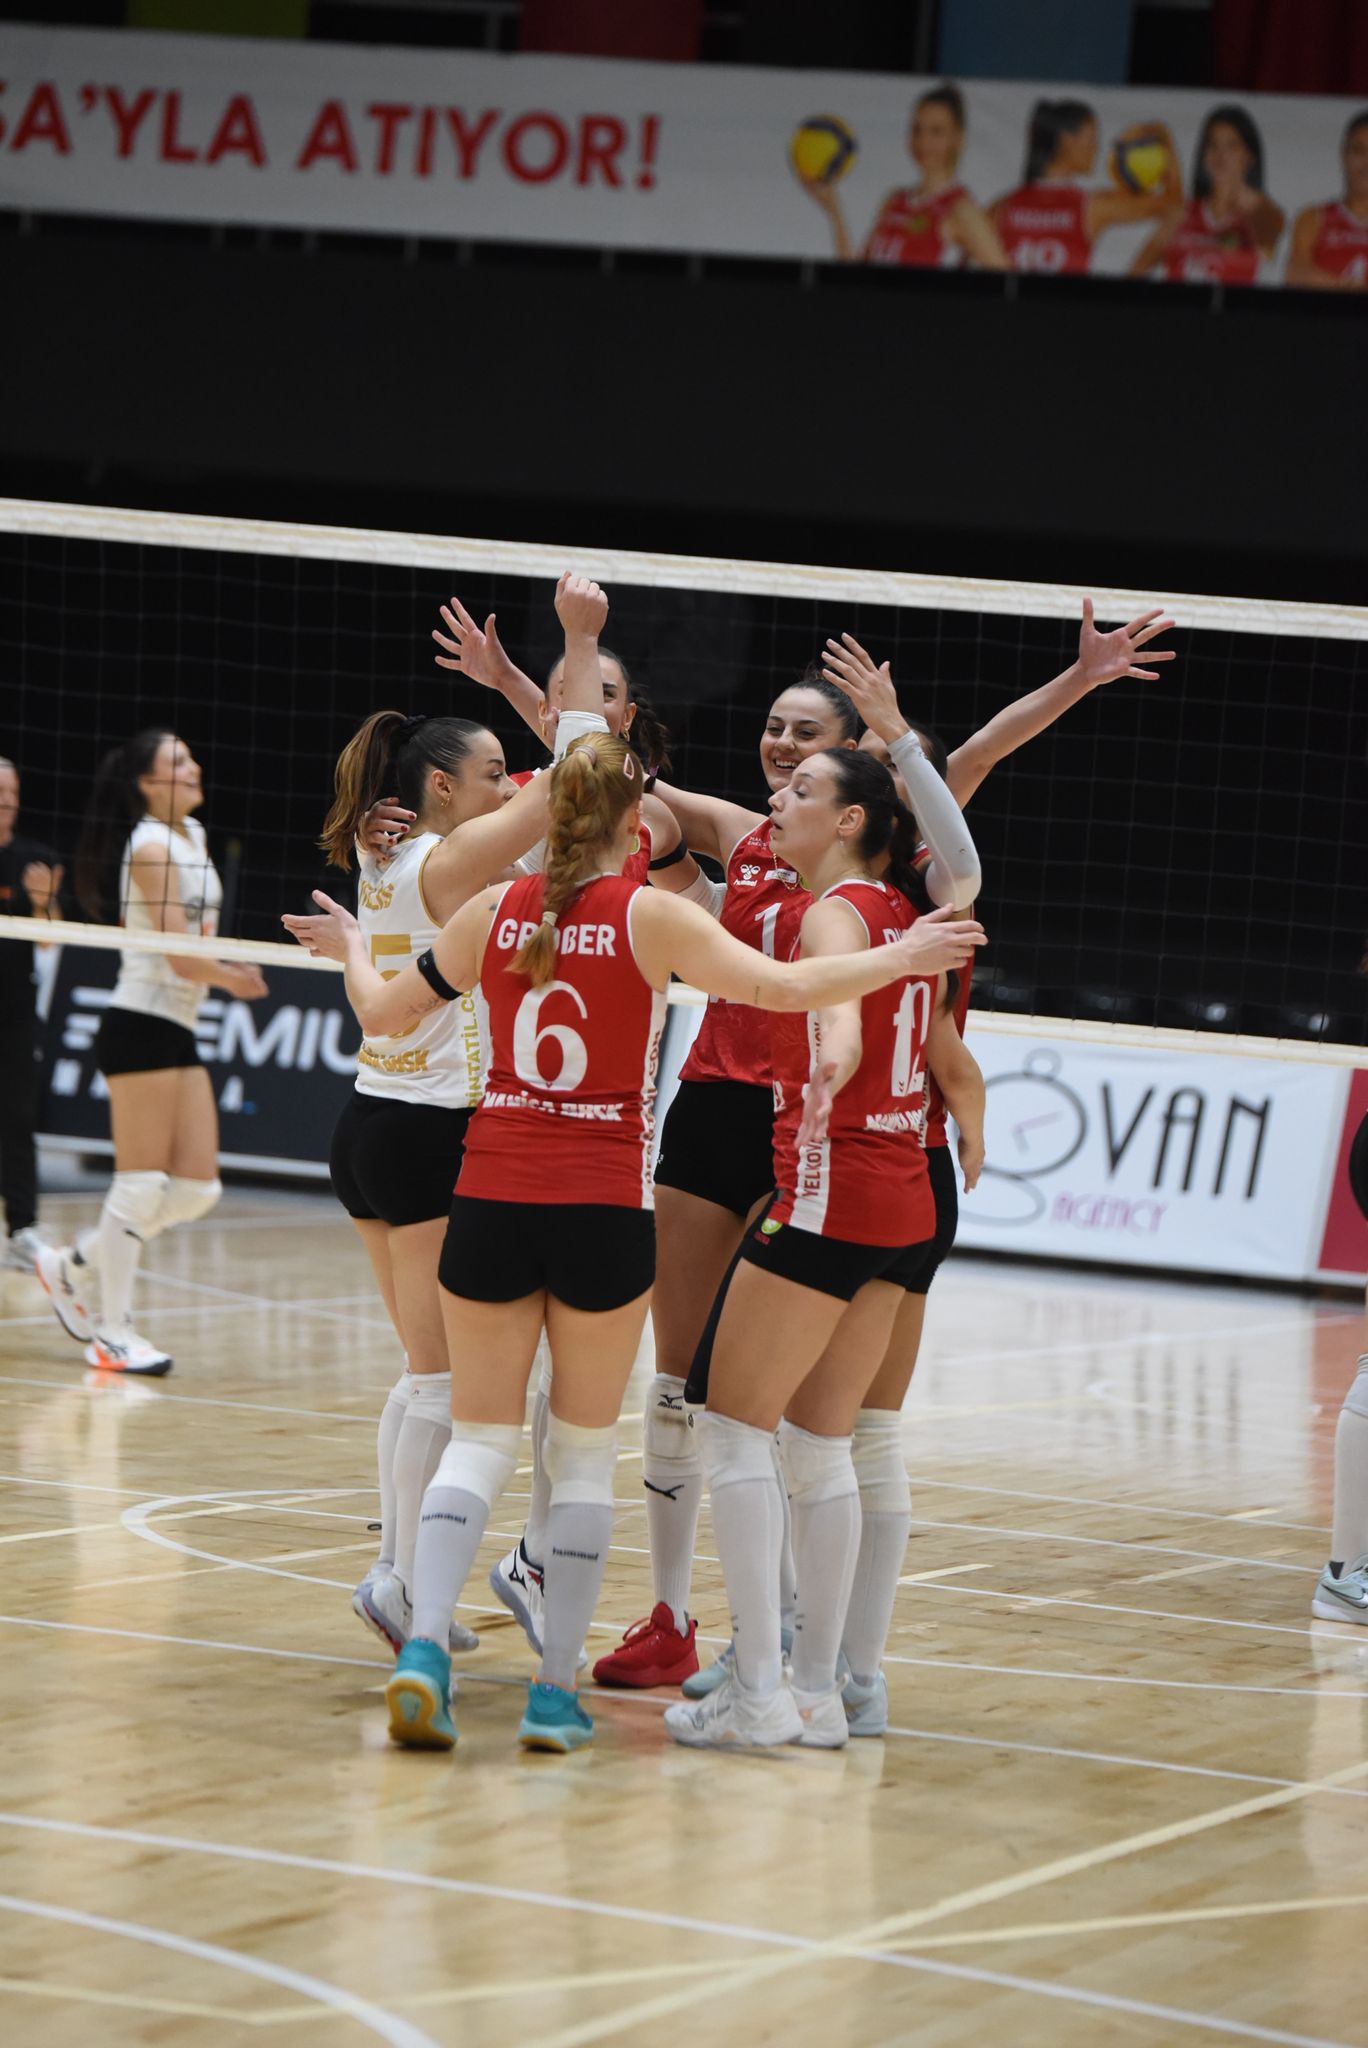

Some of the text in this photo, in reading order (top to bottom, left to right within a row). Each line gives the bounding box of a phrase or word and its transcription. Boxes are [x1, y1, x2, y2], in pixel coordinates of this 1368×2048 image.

[0, 80, 662, 191] A'YLA ATIYOR!
[513, 980, 588, 1091] 6
[802, 1139, 823, 1198] YELKOV
[552, 1547, 599, 1561] hummel
